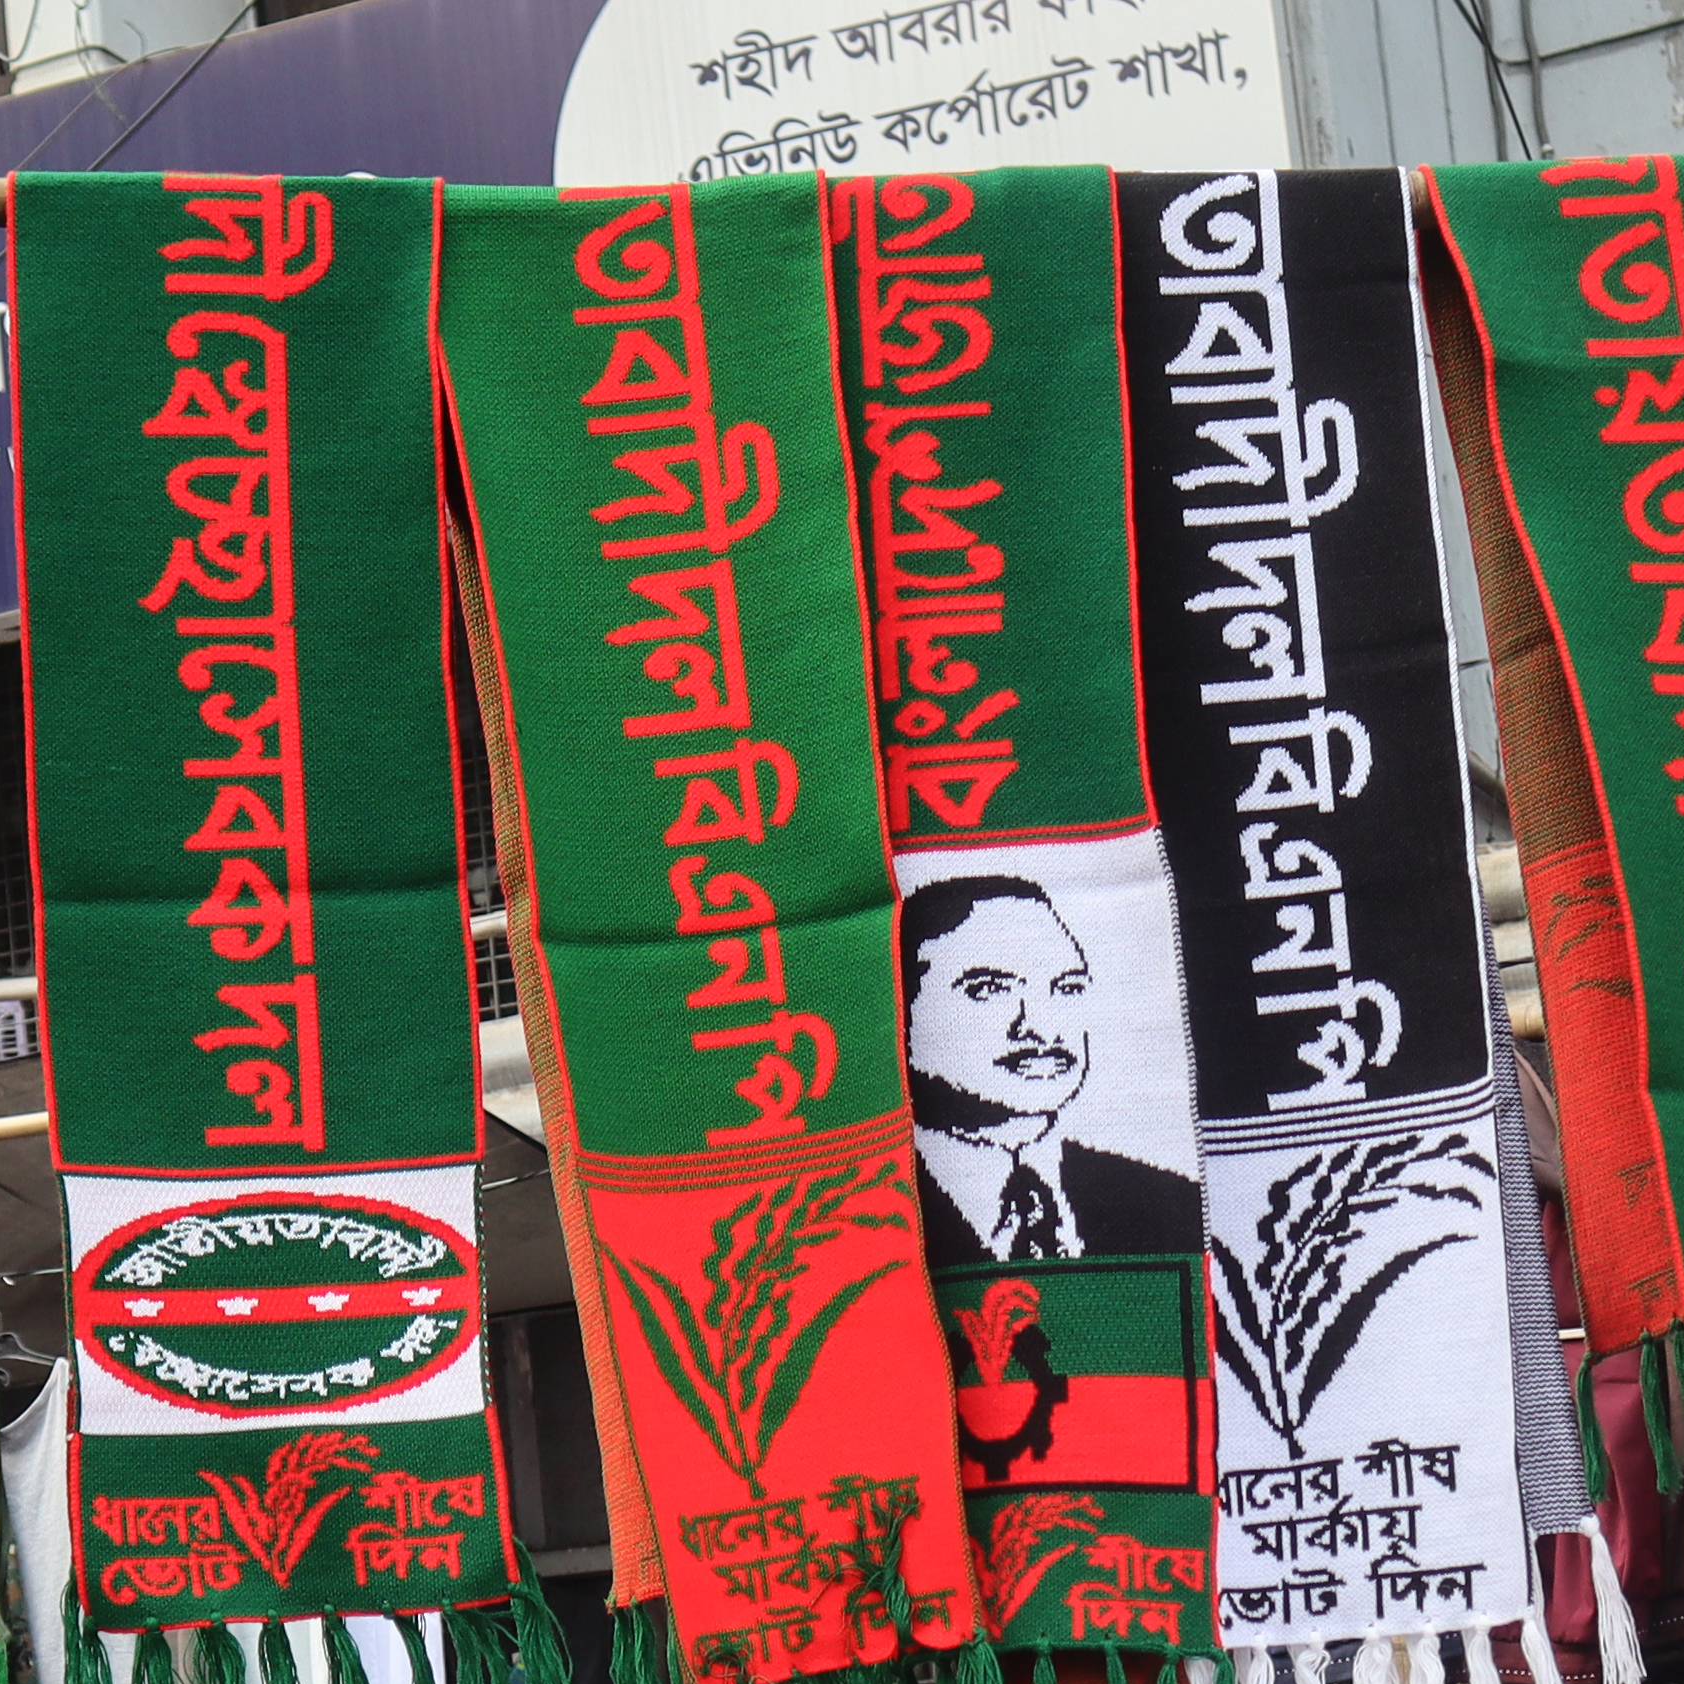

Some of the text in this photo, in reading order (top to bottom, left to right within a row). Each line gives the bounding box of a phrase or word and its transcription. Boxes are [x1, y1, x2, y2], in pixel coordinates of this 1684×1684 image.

[689, 0, 1017, 100] শহীদ আবরার
[873, 56, 1095, 153] কর্পোরেট
[559, 181, 780, 562] তাবাদী
[1156, 168, 1362, 529] তাবাদী
[139, 308, 313, 966] স্বেচ্ছাসেবক
[605, 560, 753, 740] দল
[864, 398, 1021, 830] বাংলাদেশ
[1181, 533, 1328, 705] দল
[190, 973, 327, 1153] দল
[91, 1470, 486, 1547] ধানের শীষে
[101, 1522, 465, 1605] ভোট দিন
[1242, 1493, 1423, 1561] মার্কায়
[1064, 1581, 1185, 1645] দিন
[1365, 1552, 1487, 1619] দিন
